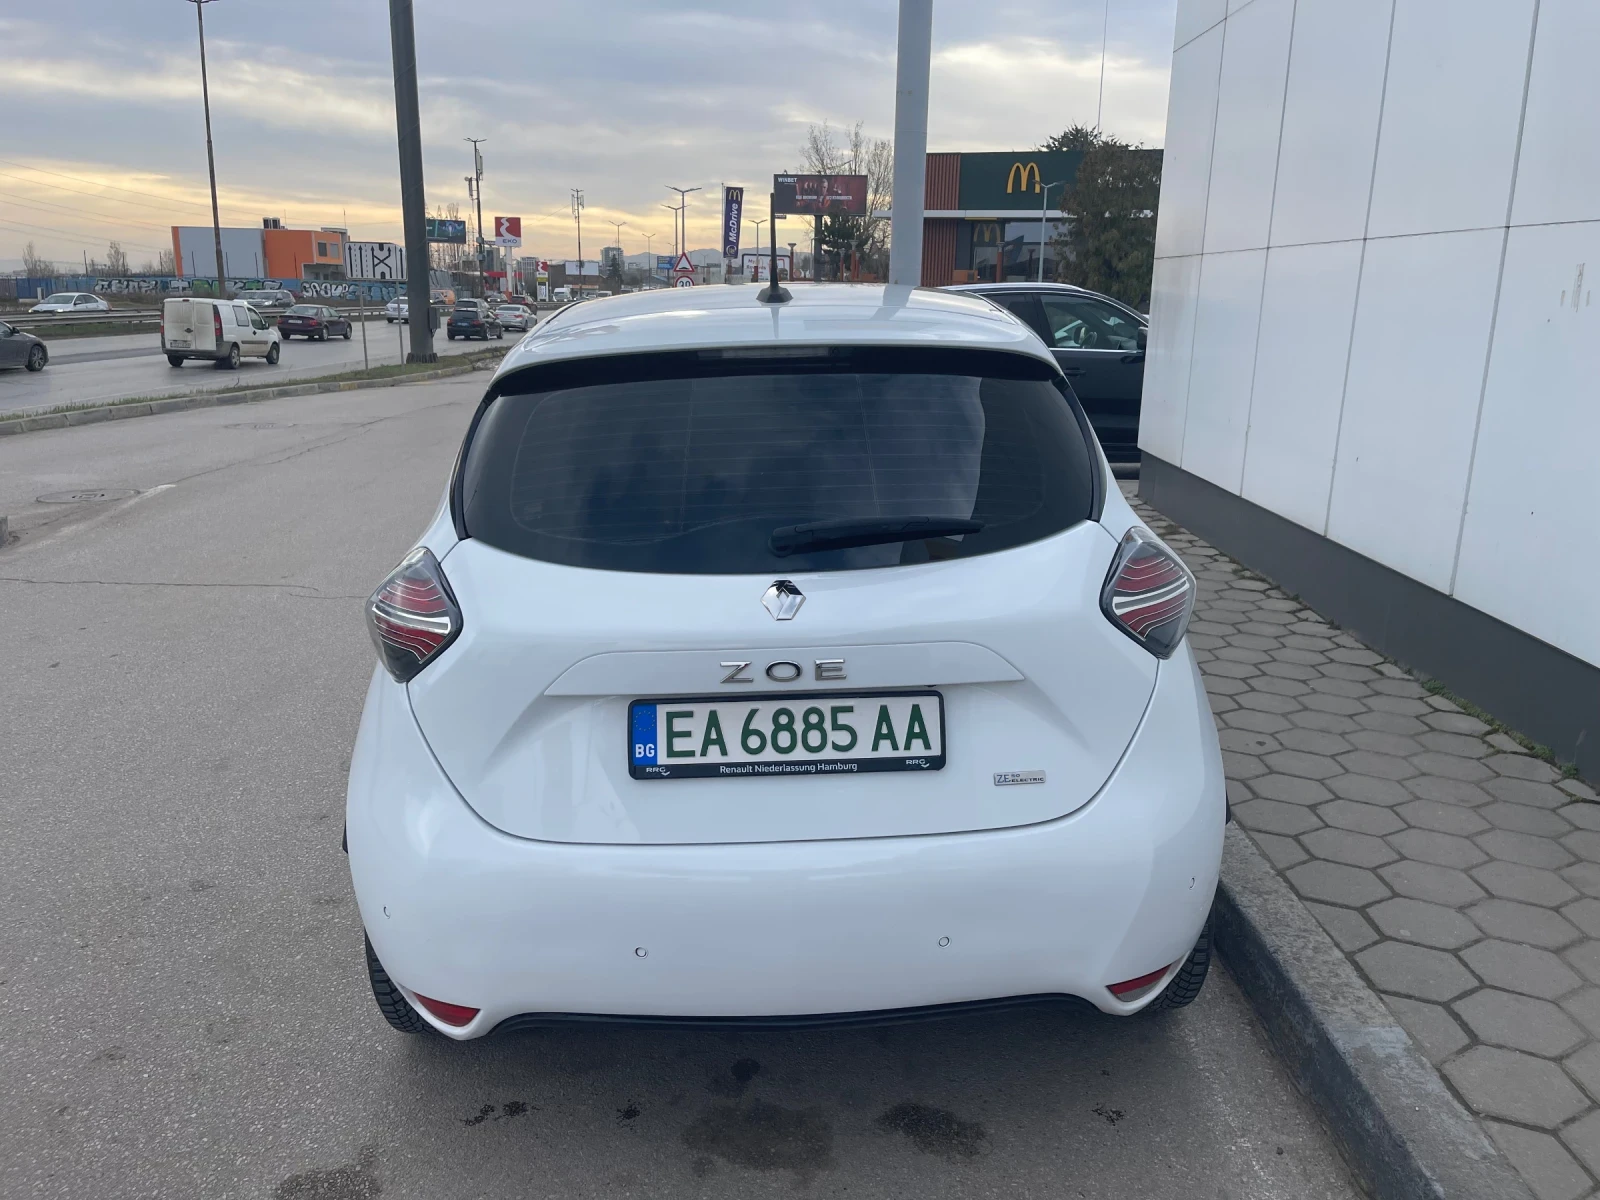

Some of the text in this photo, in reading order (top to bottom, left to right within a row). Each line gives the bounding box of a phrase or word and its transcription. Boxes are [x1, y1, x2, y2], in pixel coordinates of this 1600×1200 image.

[728, 203, 739, 243] McDrive
[720, 659, 847, 683] ZOE
[666, 704, 932, 758] EA 6885 AA
[635, 743, 655, 758] BG
[720, 762, 858, 774] Renault Niederlassung Hamburg
